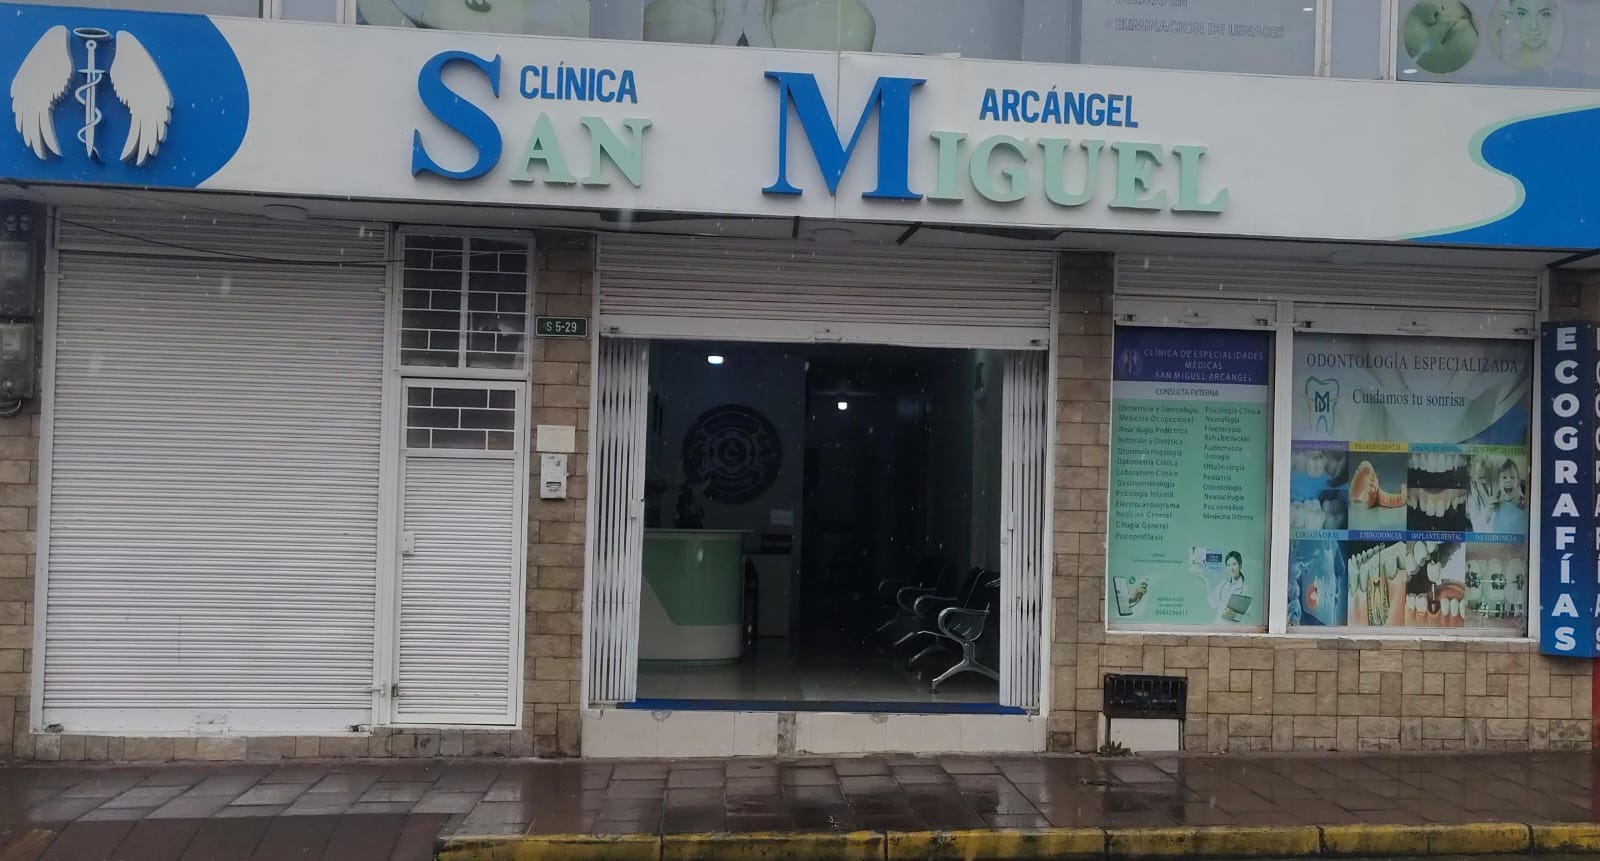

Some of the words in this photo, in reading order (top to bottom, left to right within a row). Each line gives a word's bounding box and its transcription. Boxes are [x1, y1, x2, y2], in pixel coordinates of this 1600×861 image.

[1208, 22, 1225, 36] DE
[1228, 24, 1286, 39] LUNARES
[520, 61, 638, 104] CLÍNICA
[979, 85, 1139, 129] ARCÁNGEL
[411, 50, 653, 187] SAN
[761, 70, 1229, 215] MIGUEL
[546, 321, 553, 333] S
[555, 321, 577, 333] 5-29
[1180, 350, 1191, 358] DE
[1193, 350, 1265, 361] ESPECIALIDADES
[1305, 351, 1409, 370] ODONTOLOGÍA
[1413, 354, 1519, 374] ESPECIALIZADA
[1155, 371, 1171, 380] SAN
[1173, 372, 1206, 381] MIGUEL
[1155, 388, 1189, 397] CONSULTA
[1190, 388, 1219, 397] EXTERNA
[1352, 388, 1409, 406] Cuidamos
[1411, 391, 1423, 406] tu
[1425, 390, 1466, 408] sonrisa
[1551, 327, 1580, 651] ECOGRAFÍAS
